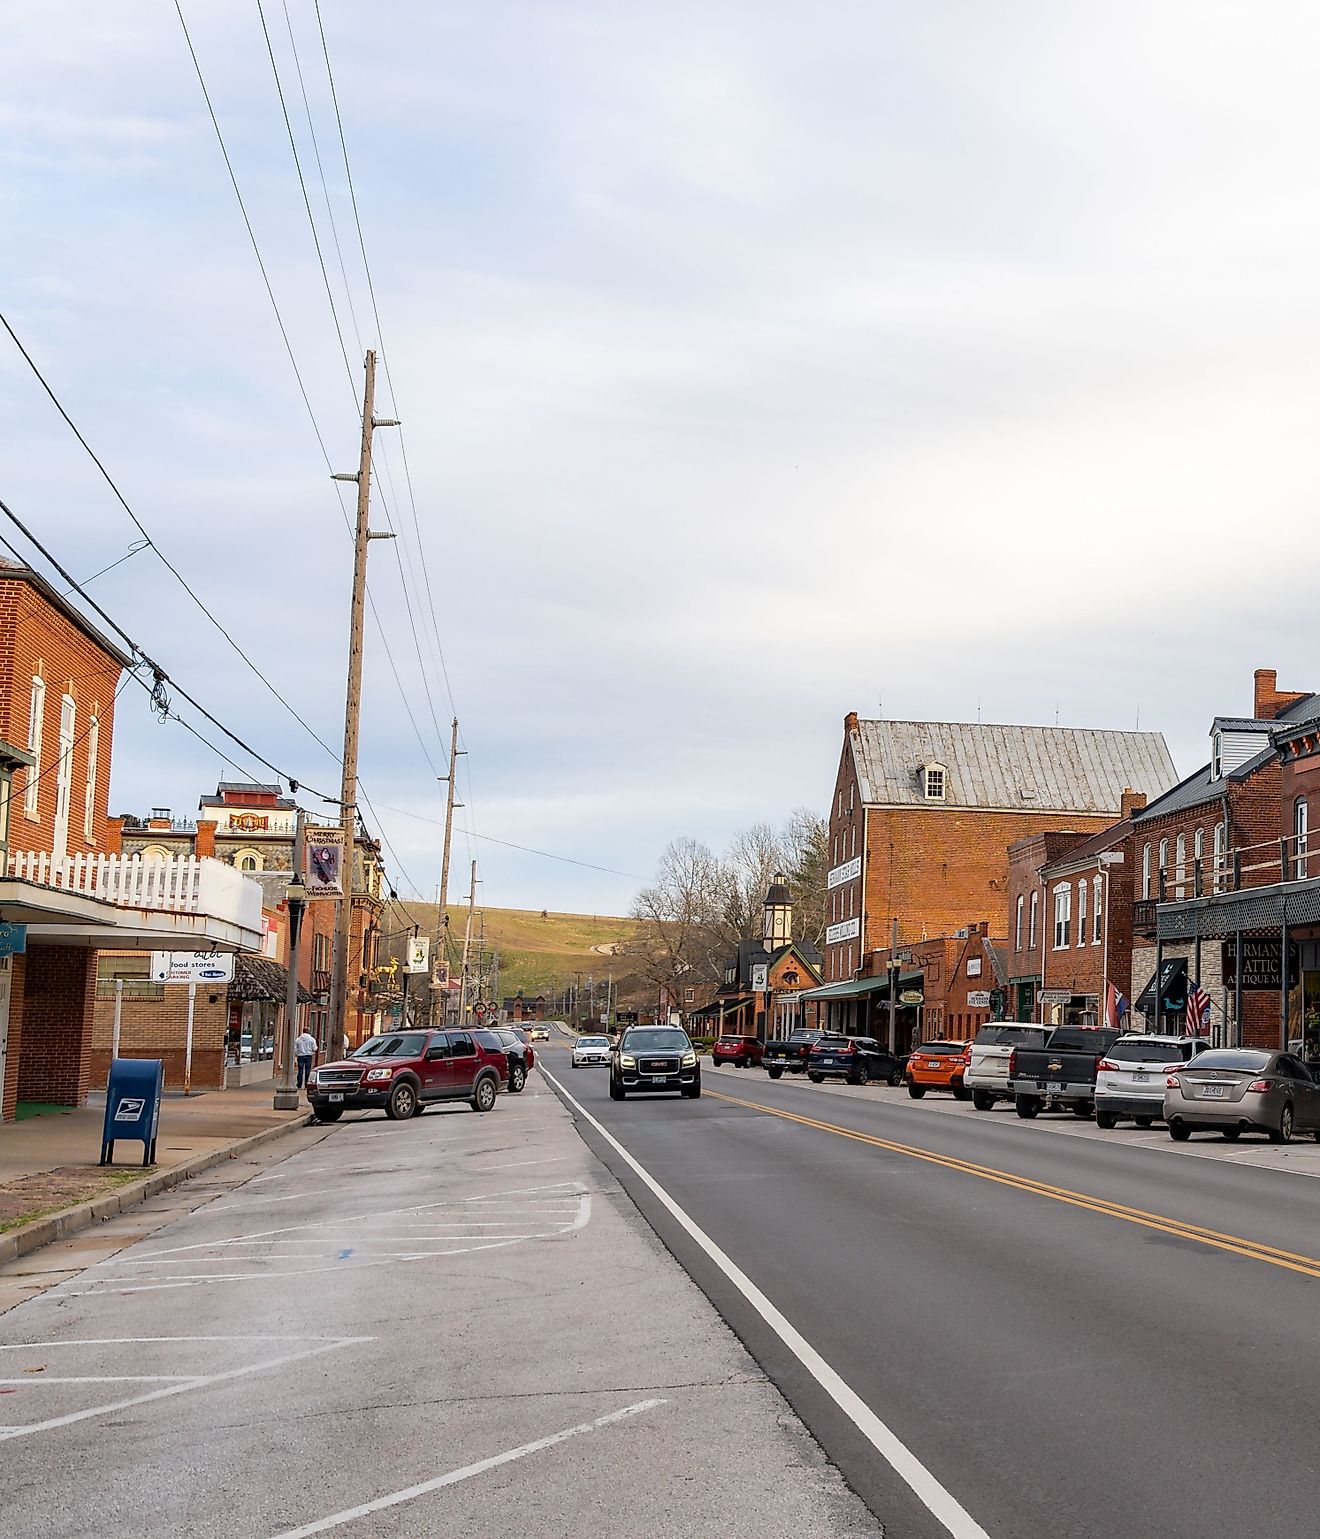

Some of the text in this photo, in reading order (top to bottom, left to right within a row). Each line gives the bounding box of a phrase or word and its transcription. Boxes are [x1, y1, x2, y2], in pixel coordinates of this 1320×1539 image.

[313, 831, 337, 839] MERRY
[1227, 943, 1296, 957] HRMANS
[1243, 959, 1279, 973] ATTIC
[1271, 974, 1297, 984] ML
